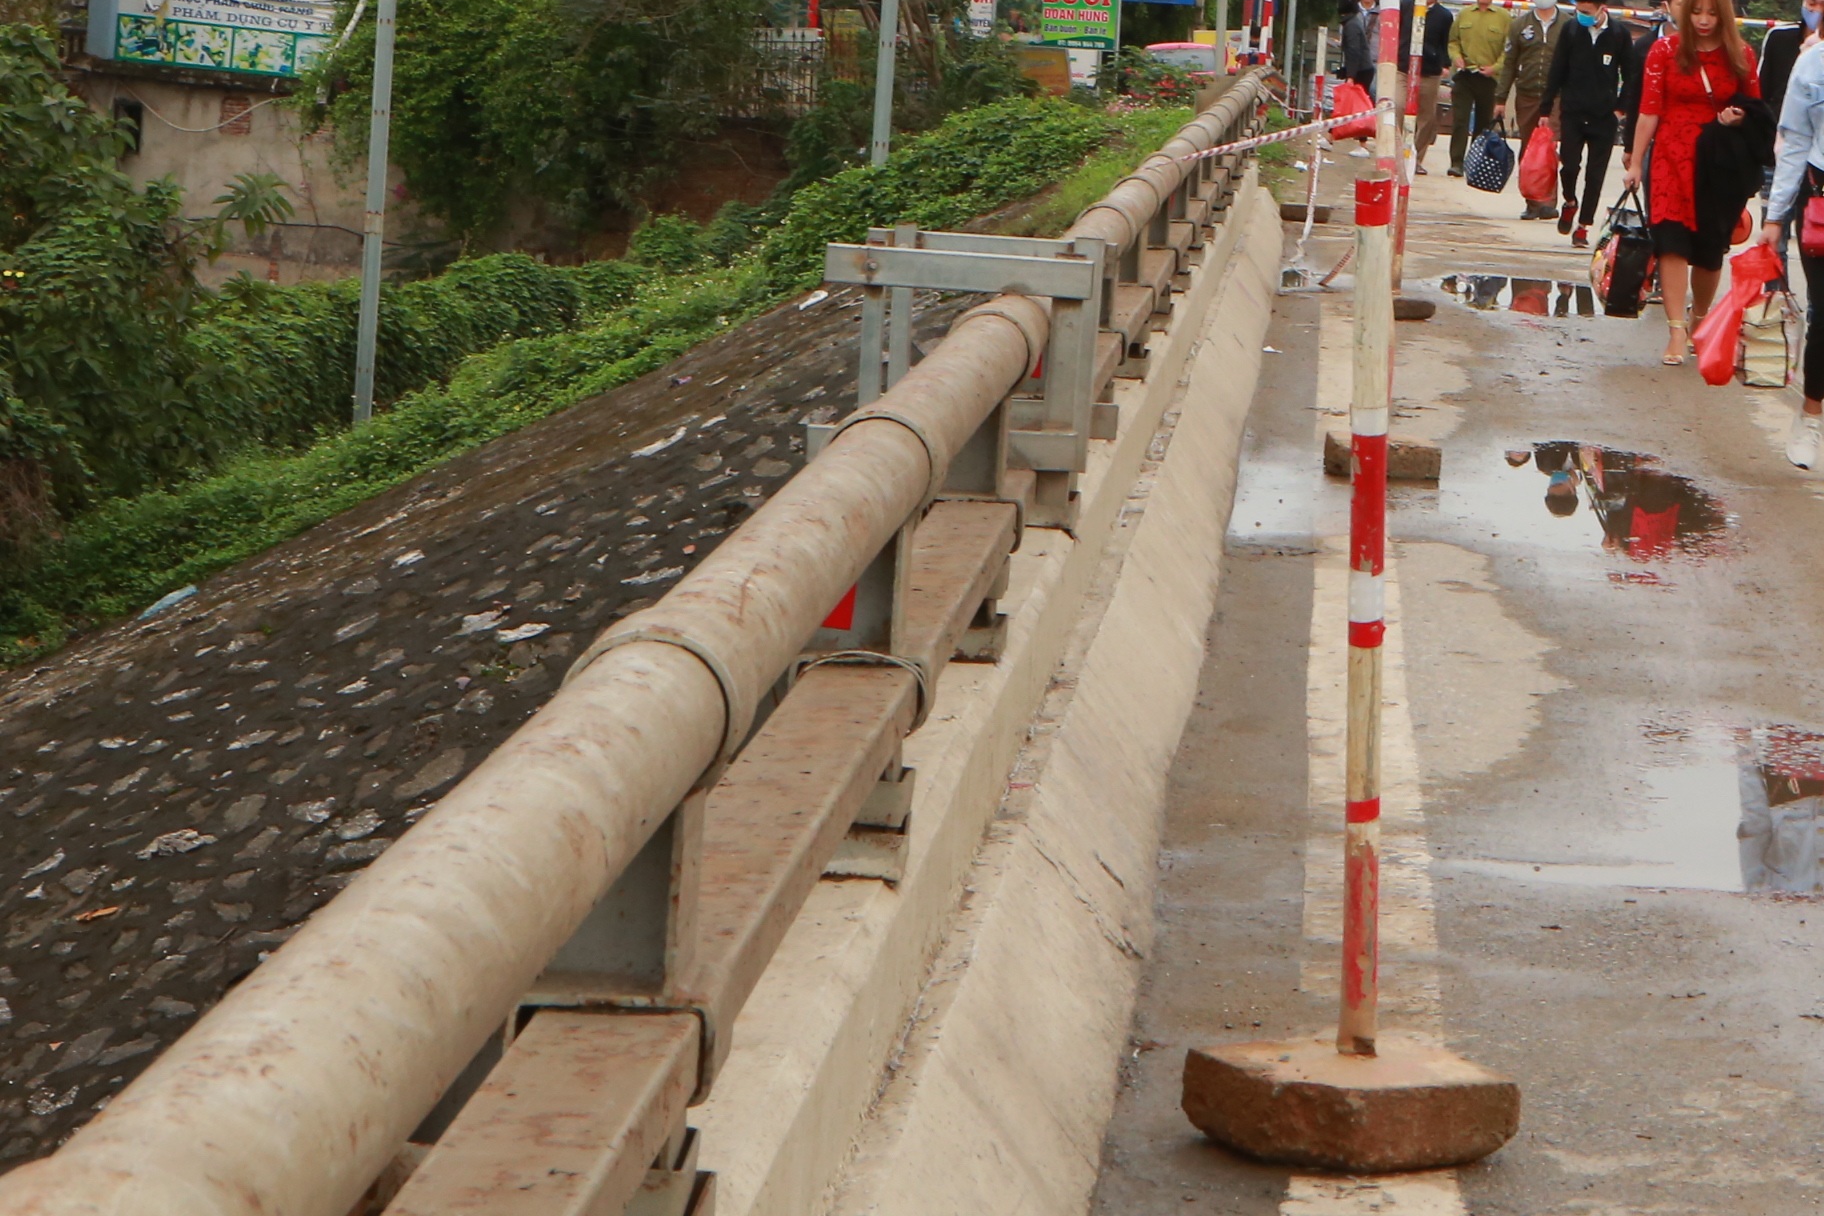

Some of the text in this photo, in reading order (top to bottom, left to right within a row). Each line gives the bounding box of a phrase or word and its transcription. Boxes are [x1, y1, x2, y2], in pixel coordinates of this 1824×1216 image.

[226, 12, 272, 26] DỤNG
[277, 18, 298, 31] CỤ
[304, 20, 314, 30] Y
